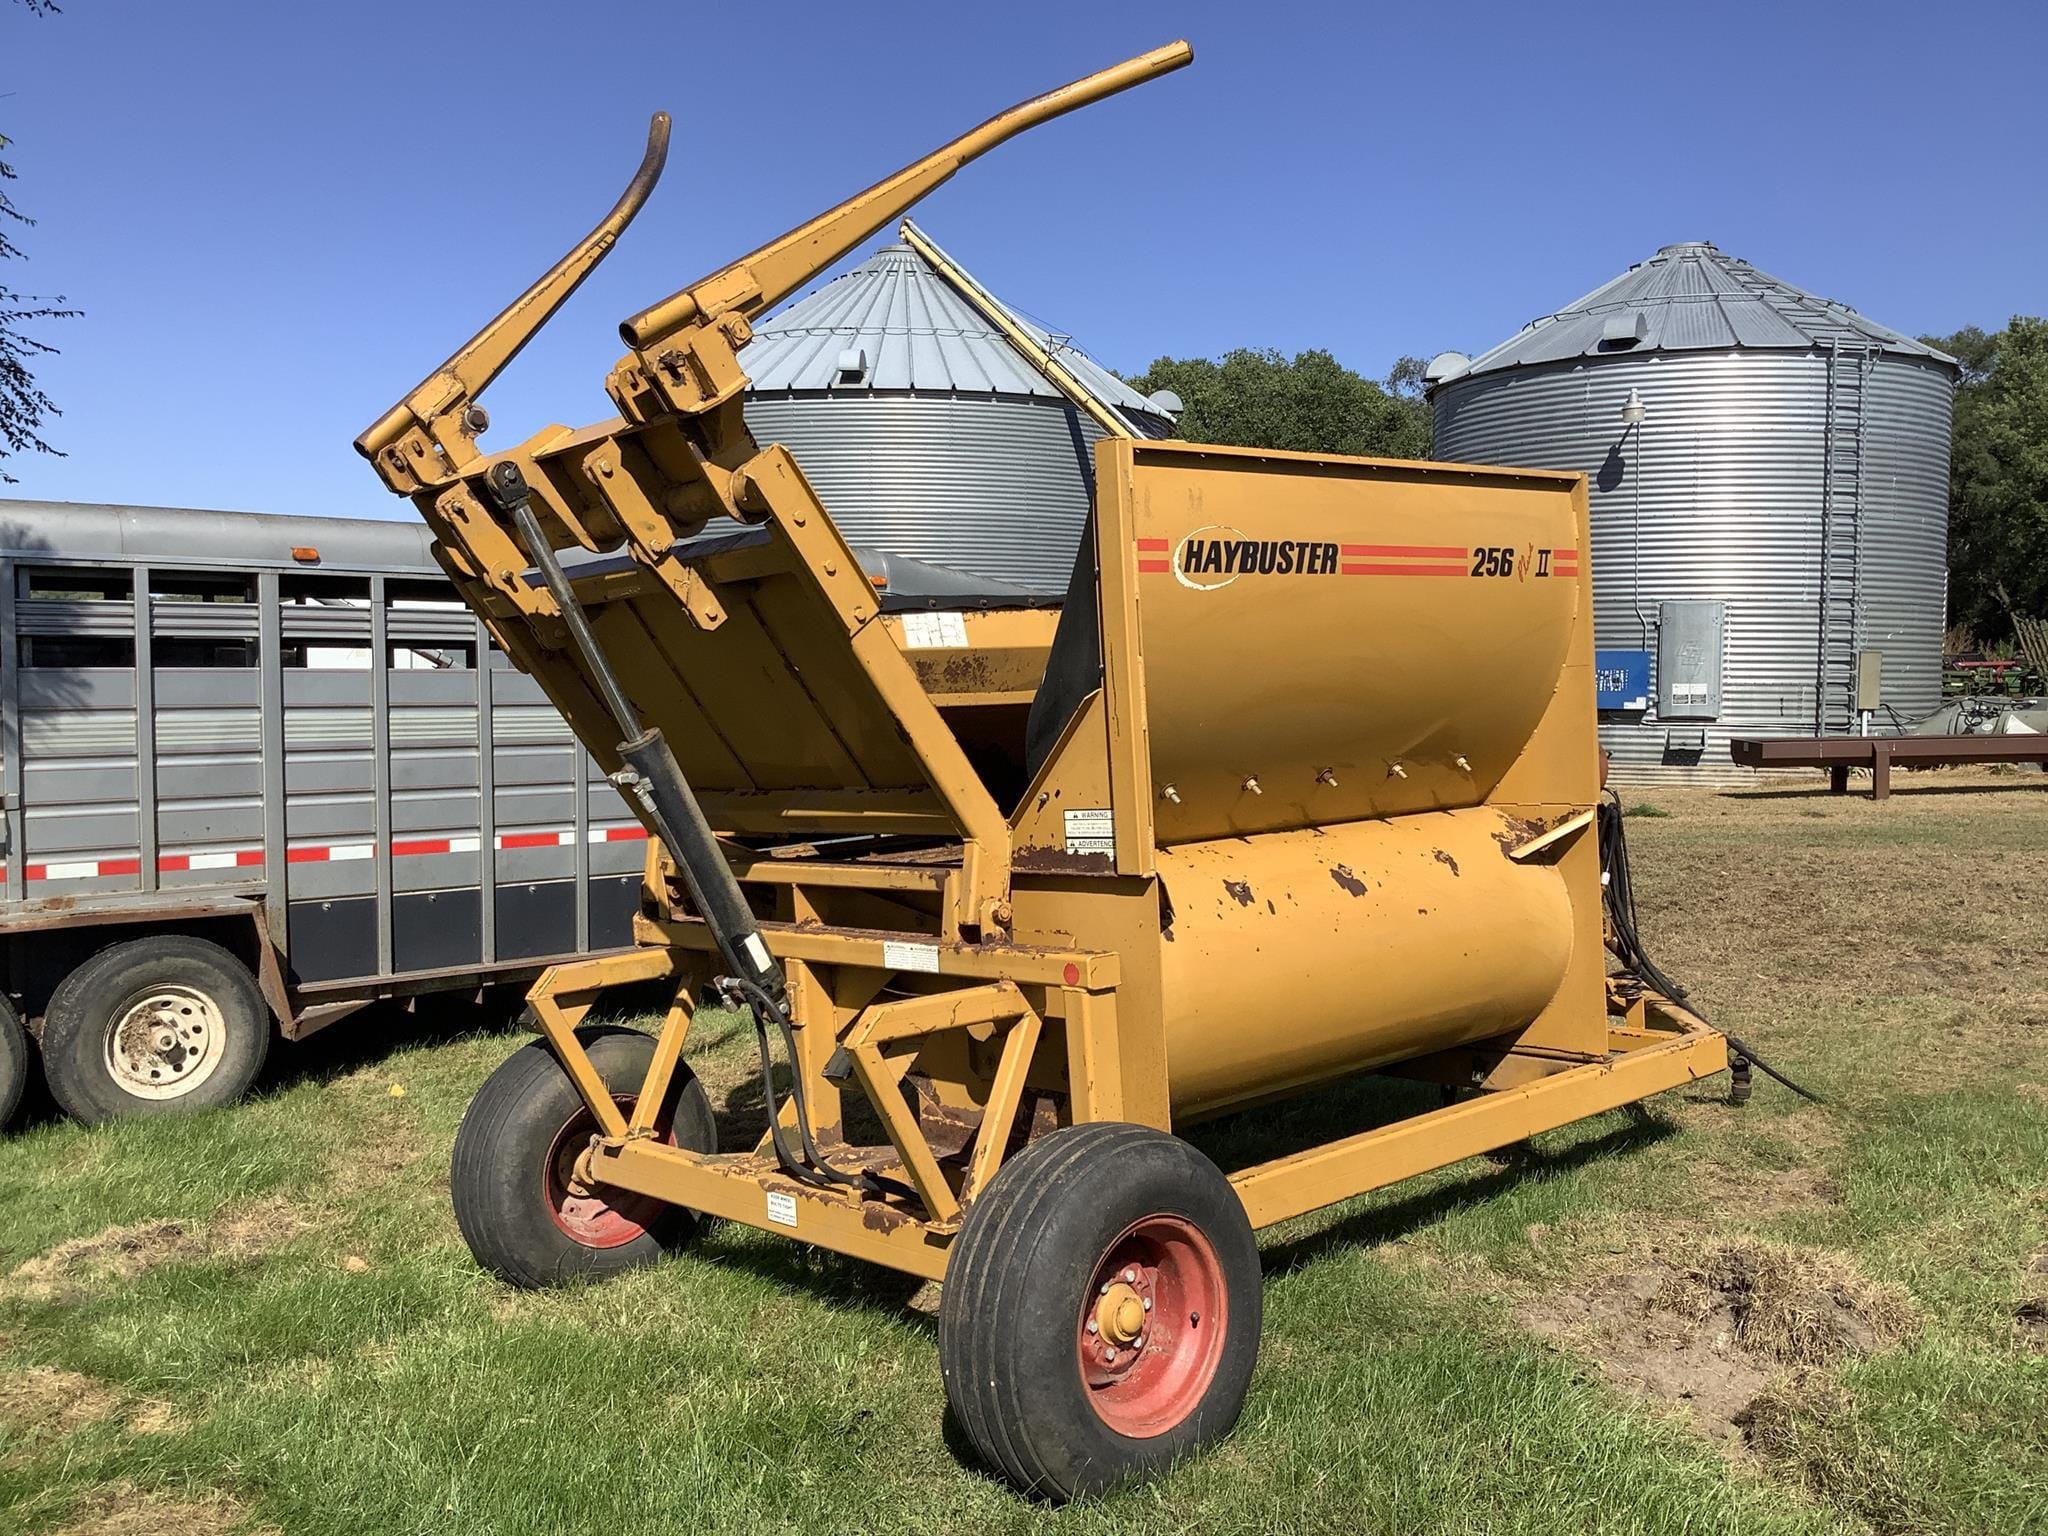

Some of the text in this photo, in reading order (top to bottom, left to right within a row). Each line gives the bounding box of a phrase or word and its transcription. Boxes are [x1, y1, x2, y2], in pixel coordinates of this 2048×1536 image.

[1183, 539, 1339, 575] HAYBUSTER
[1471, 547, 1515, 577] 256
[1535, 549, 1552, 577] II
